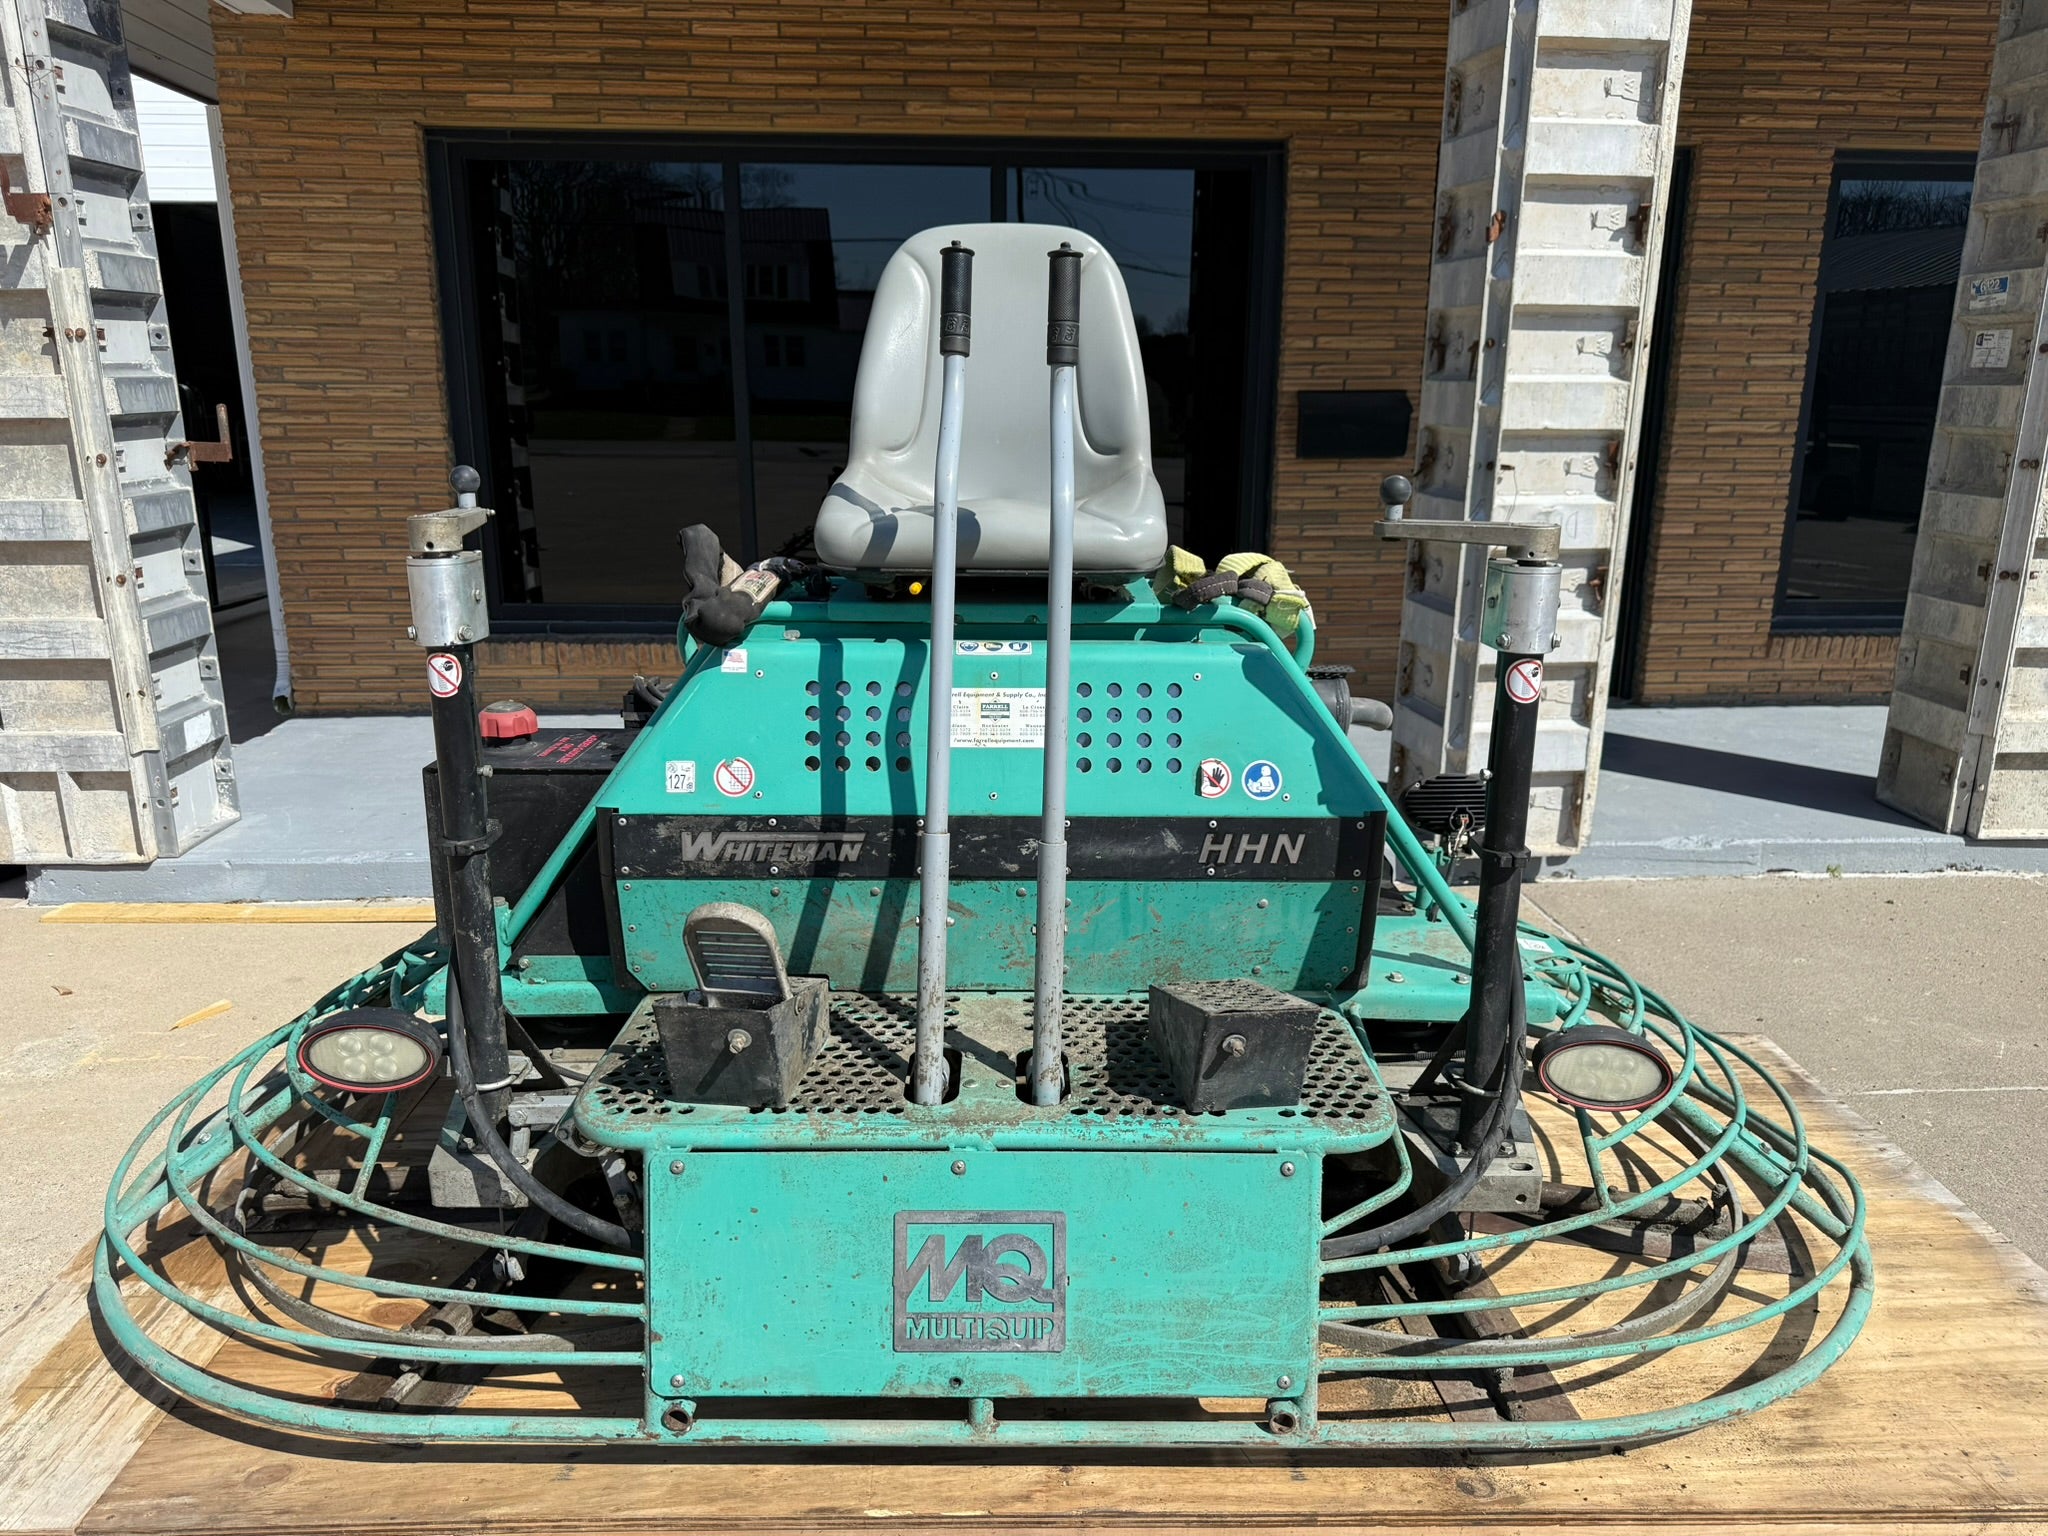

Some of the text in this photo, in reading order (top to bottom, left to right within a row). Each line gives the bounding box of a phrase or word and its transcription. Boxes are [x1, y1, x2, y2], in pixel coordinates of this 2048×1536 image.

[668, 774, 686, 789] 127
[680, 831, 867, 862] WHITEMAN
[1198, 833, 1306, 864] HHN
[904, 1233, 1056, 1303] MQ
[905, 1317, 1055, 1340] MULTIQUIP
